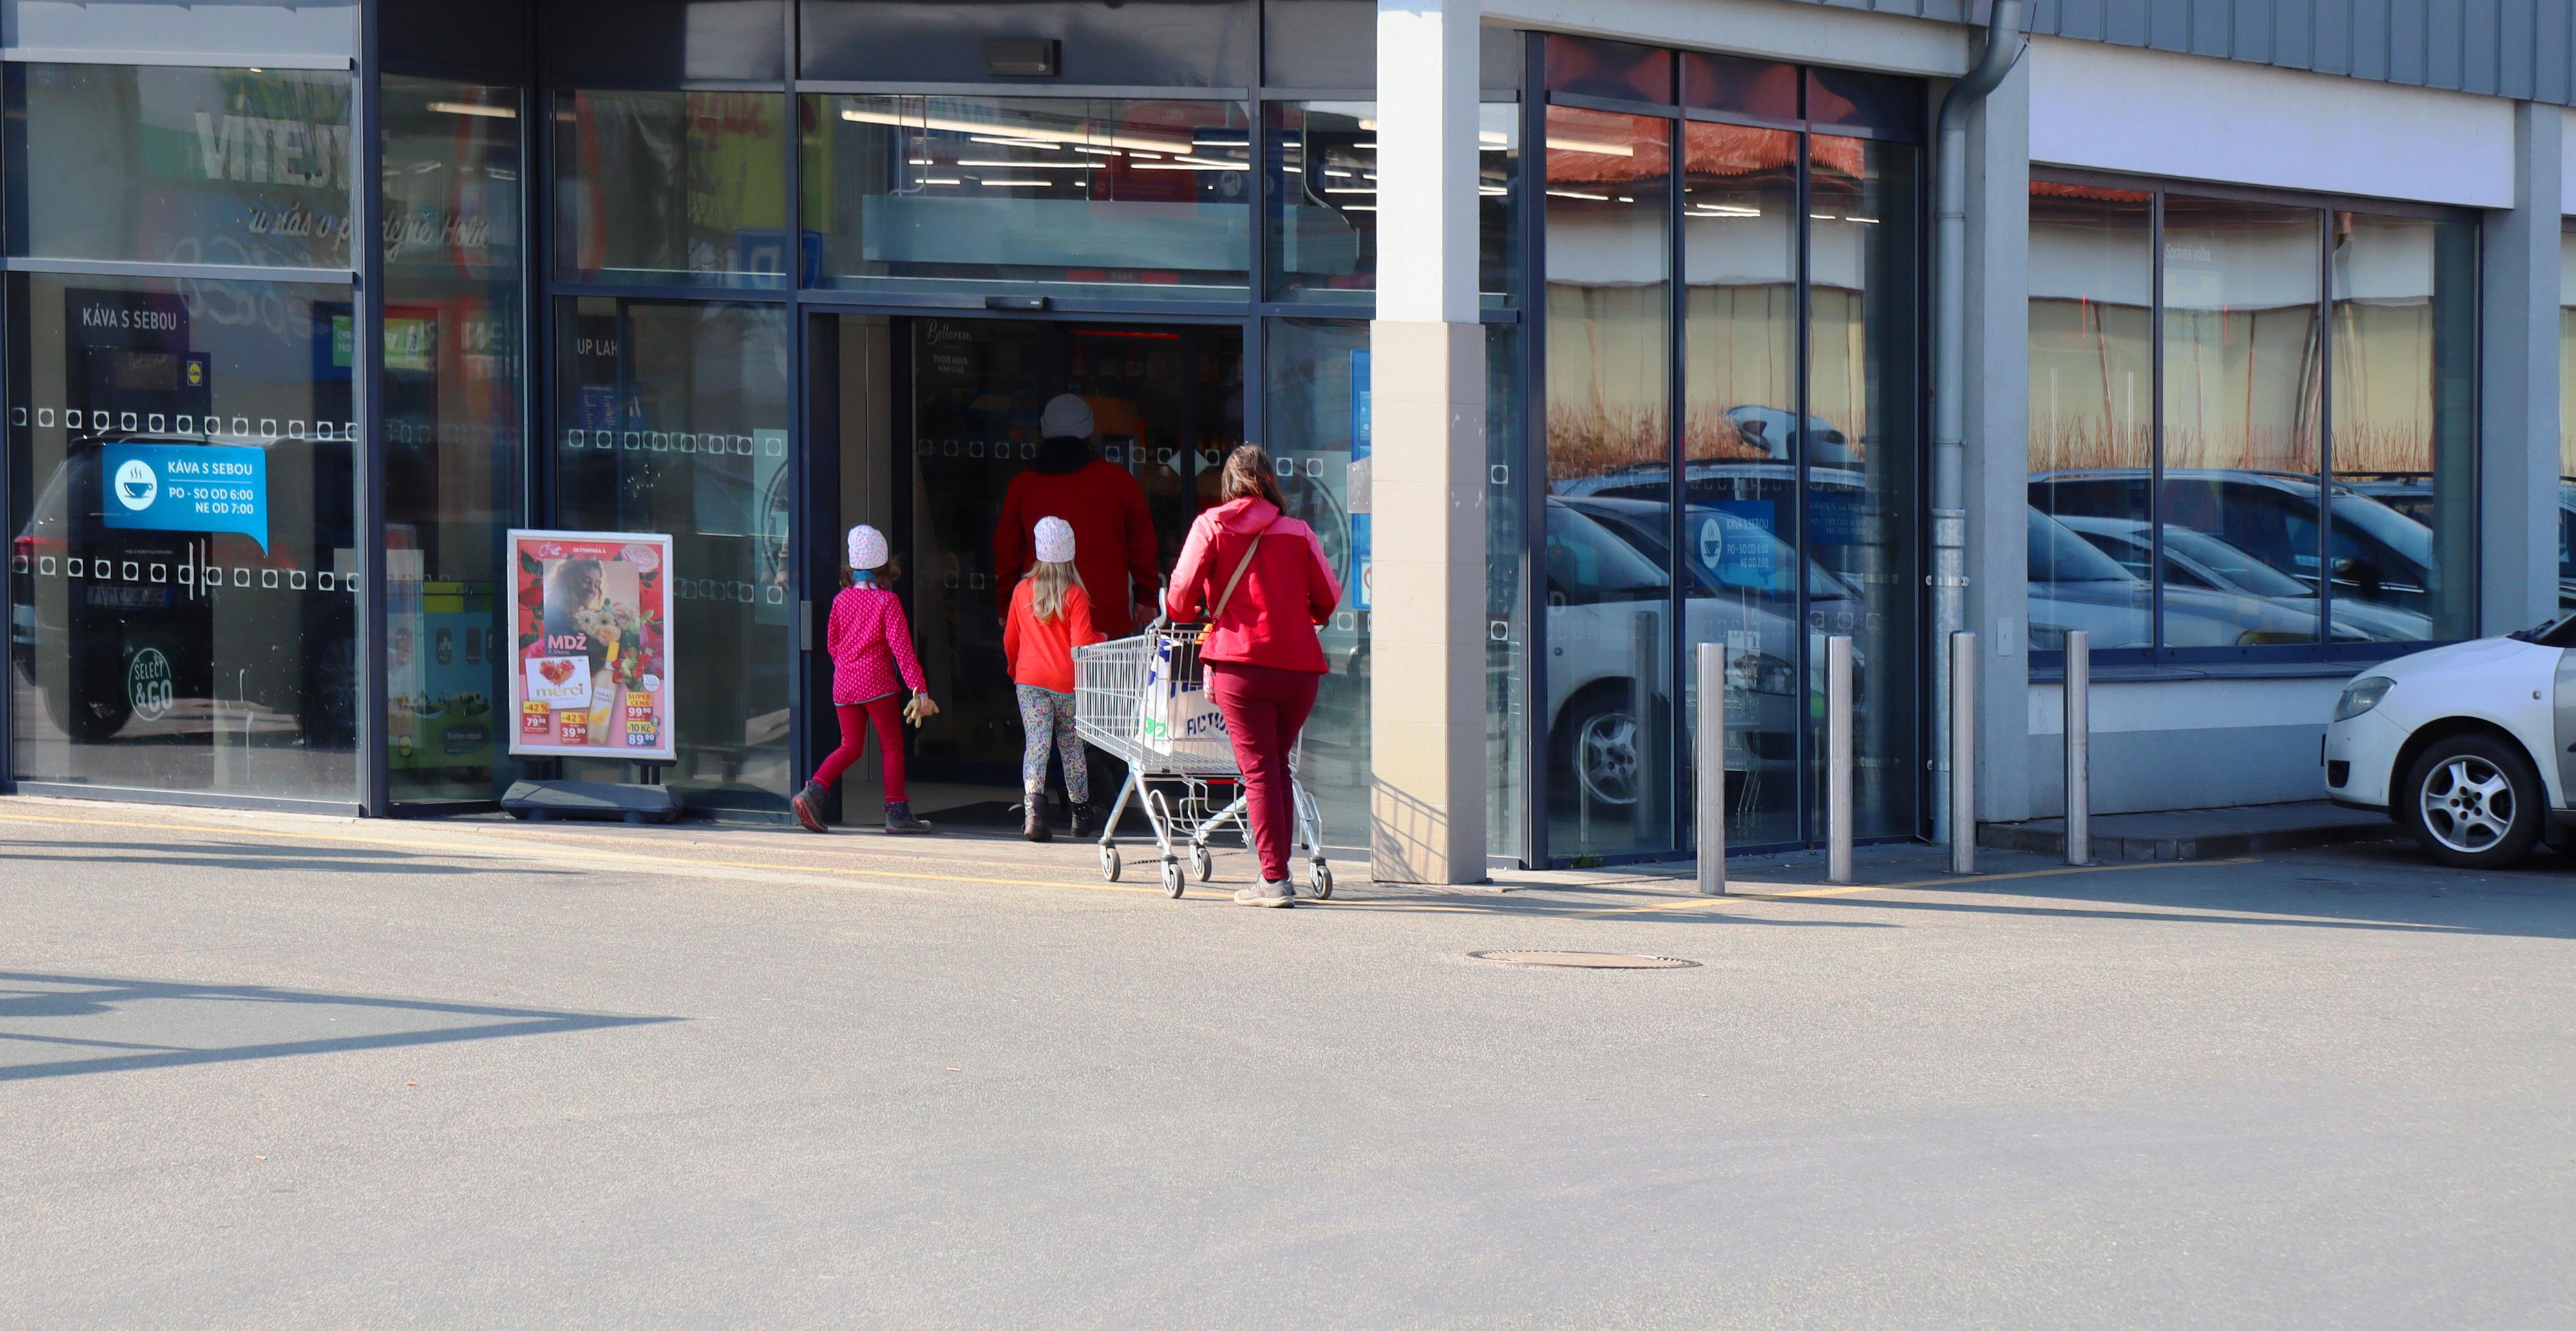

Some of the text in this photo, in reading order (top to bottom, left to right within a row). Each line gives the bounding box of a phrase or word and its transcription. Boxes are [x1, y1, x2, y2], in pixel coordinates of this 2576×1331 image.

[82, 302, 176, 330] KÁVA S SEBOU
[167, 459, 252, 475] KÁVA S SEBOU
[169, 487, 185, 498] PO
[194, 488, 209, 500] SO
[211, 489, 226, 500] OD
[230, 490, 253, 501] 6:00
[196, 502, 254, 515] NE OD 7:00
[1727, 544, 1735, 554] PO
[1739, 544, 1747, 554] SO
[1748, 544, 1756, 555] OD
[1740, 557, 1748, 568] NE
[1748, 557, 1756, 568] OD
[548, 633, 587, 650] MDŽ
[134, 660, 164, 680] SELECT
[536, 683, 584, 696] merci
[525, 704, 548, 713] -42 %
[628, 723, 651, 733] -10 Kč
